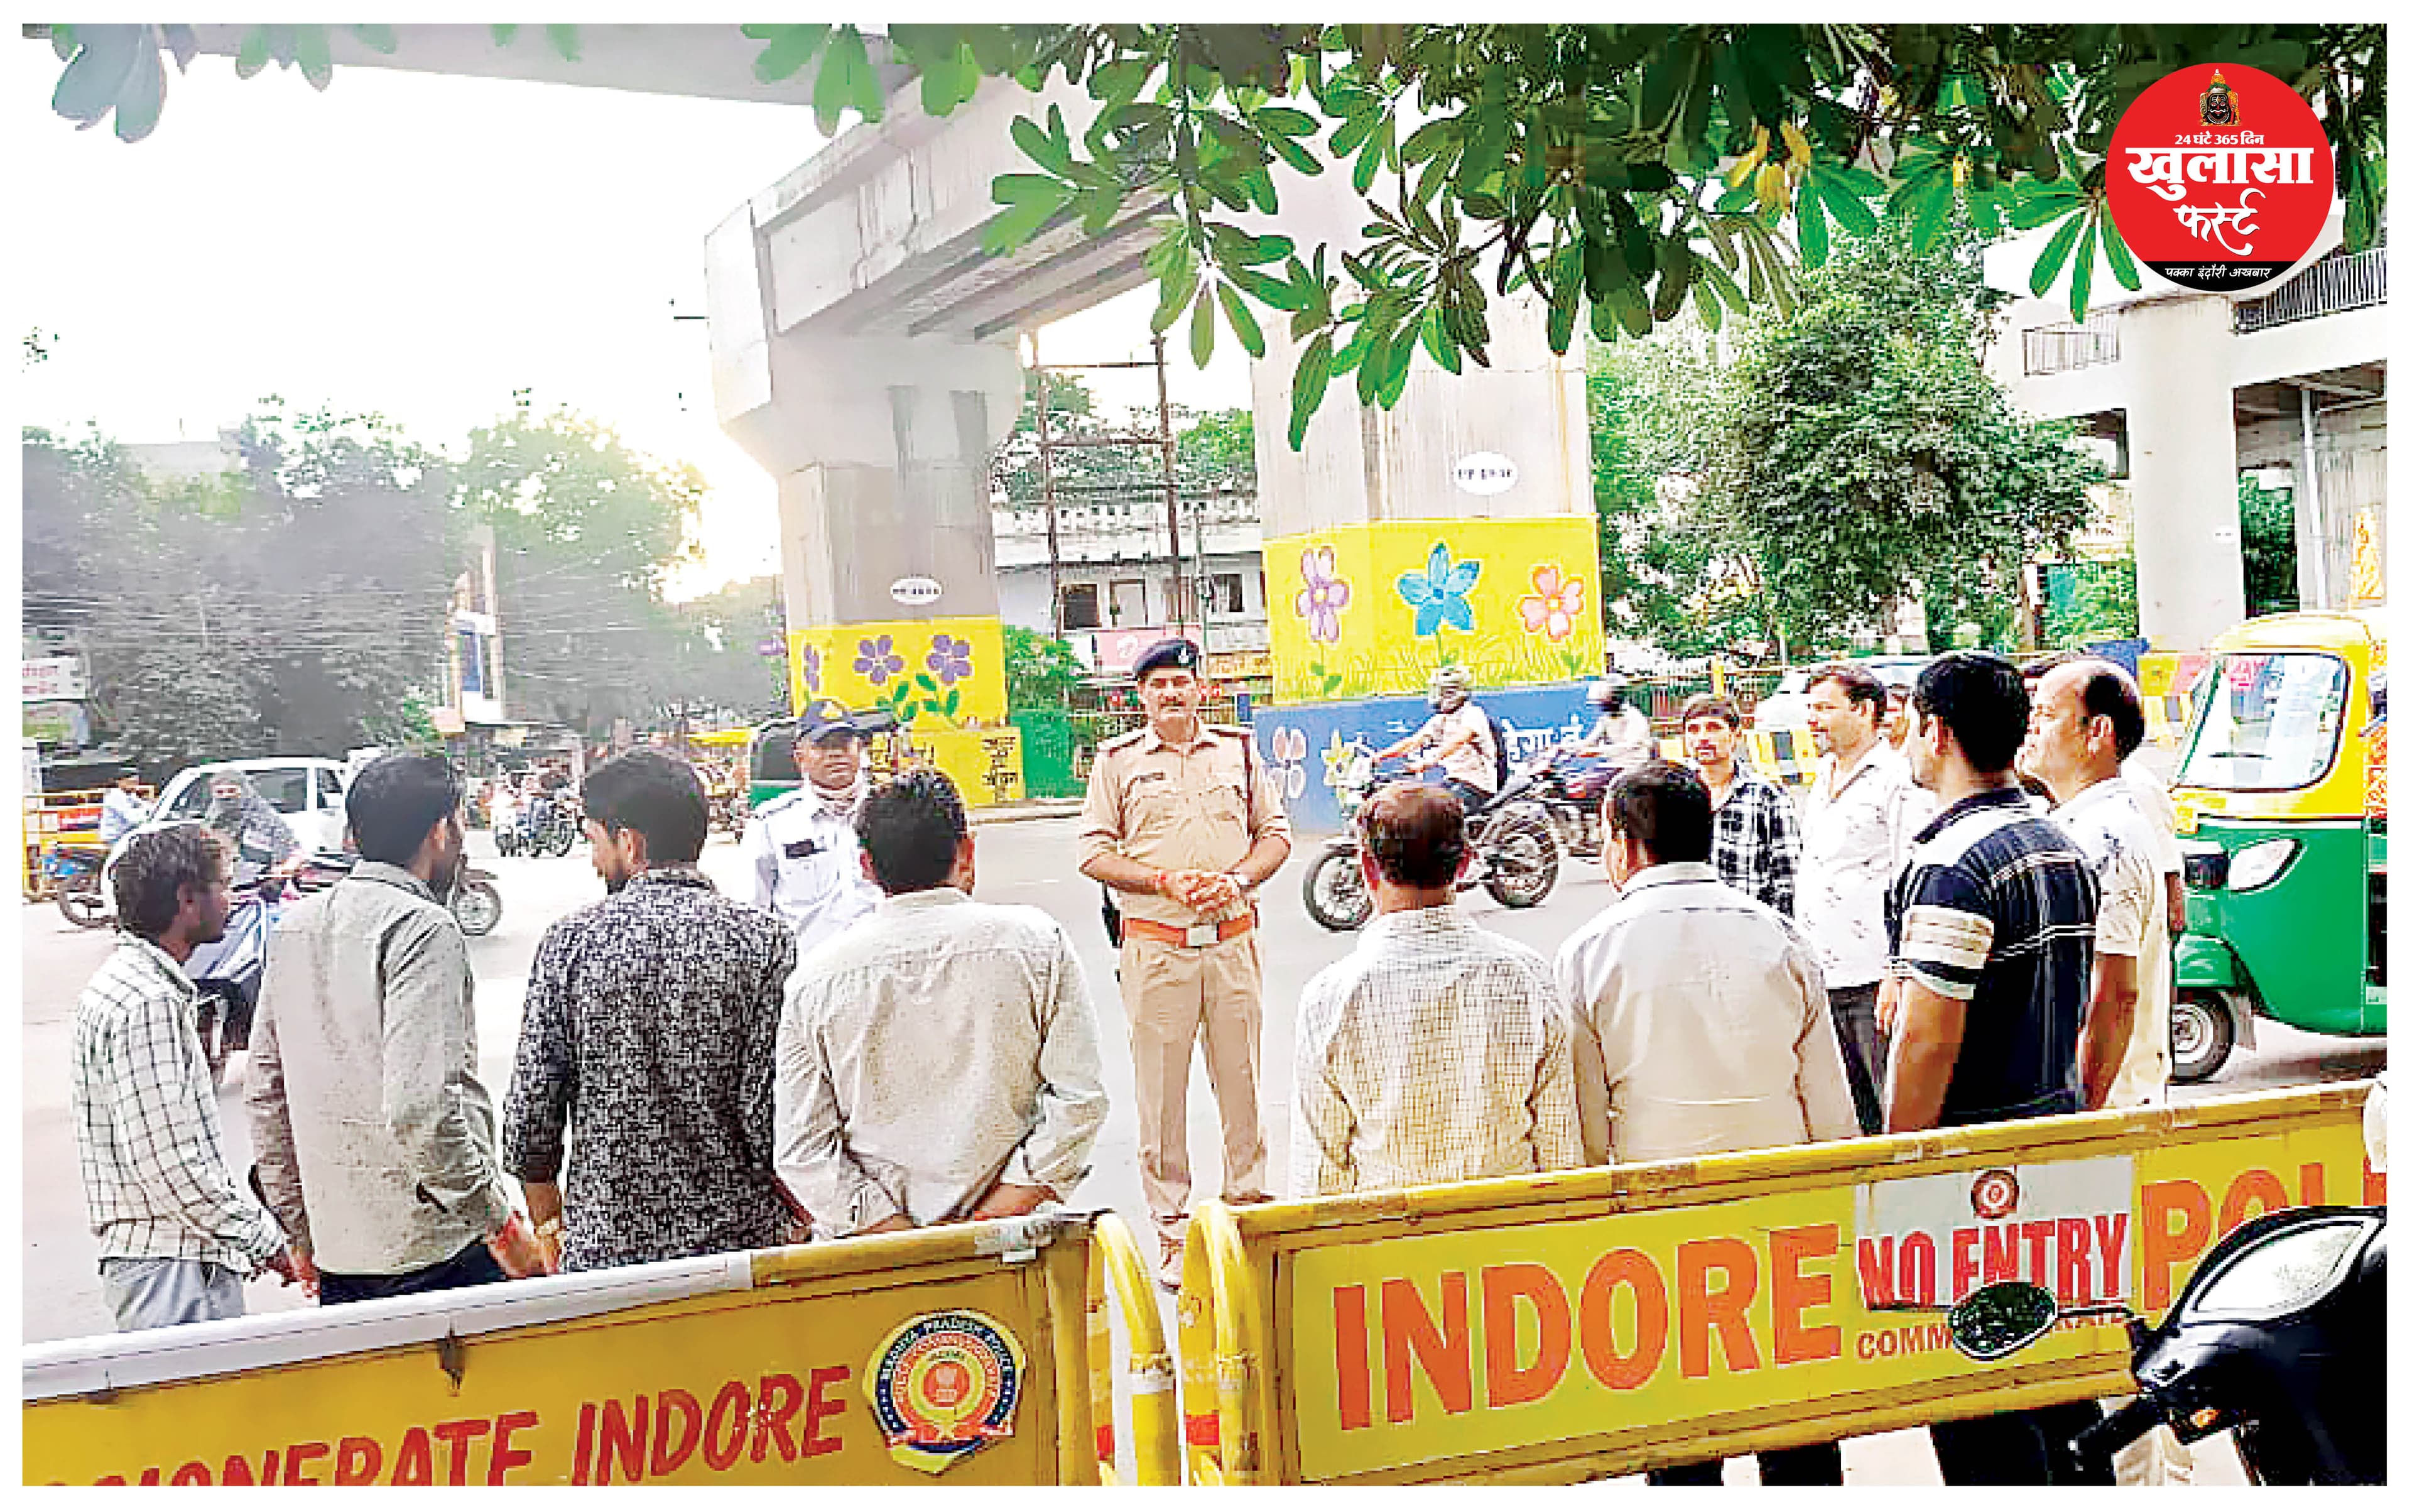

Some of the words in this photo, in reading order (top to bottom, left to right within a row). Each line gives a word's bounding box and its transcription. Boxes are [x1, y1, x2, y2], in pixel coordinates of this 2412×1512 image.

[1857, 1229, 1937, 1310] NO
[1952, 1213, 2128, 1309] ENTRY
[1333, 1223, 1842, 1431] INDORE
[571, 1365, 852, 1486] INDORE
